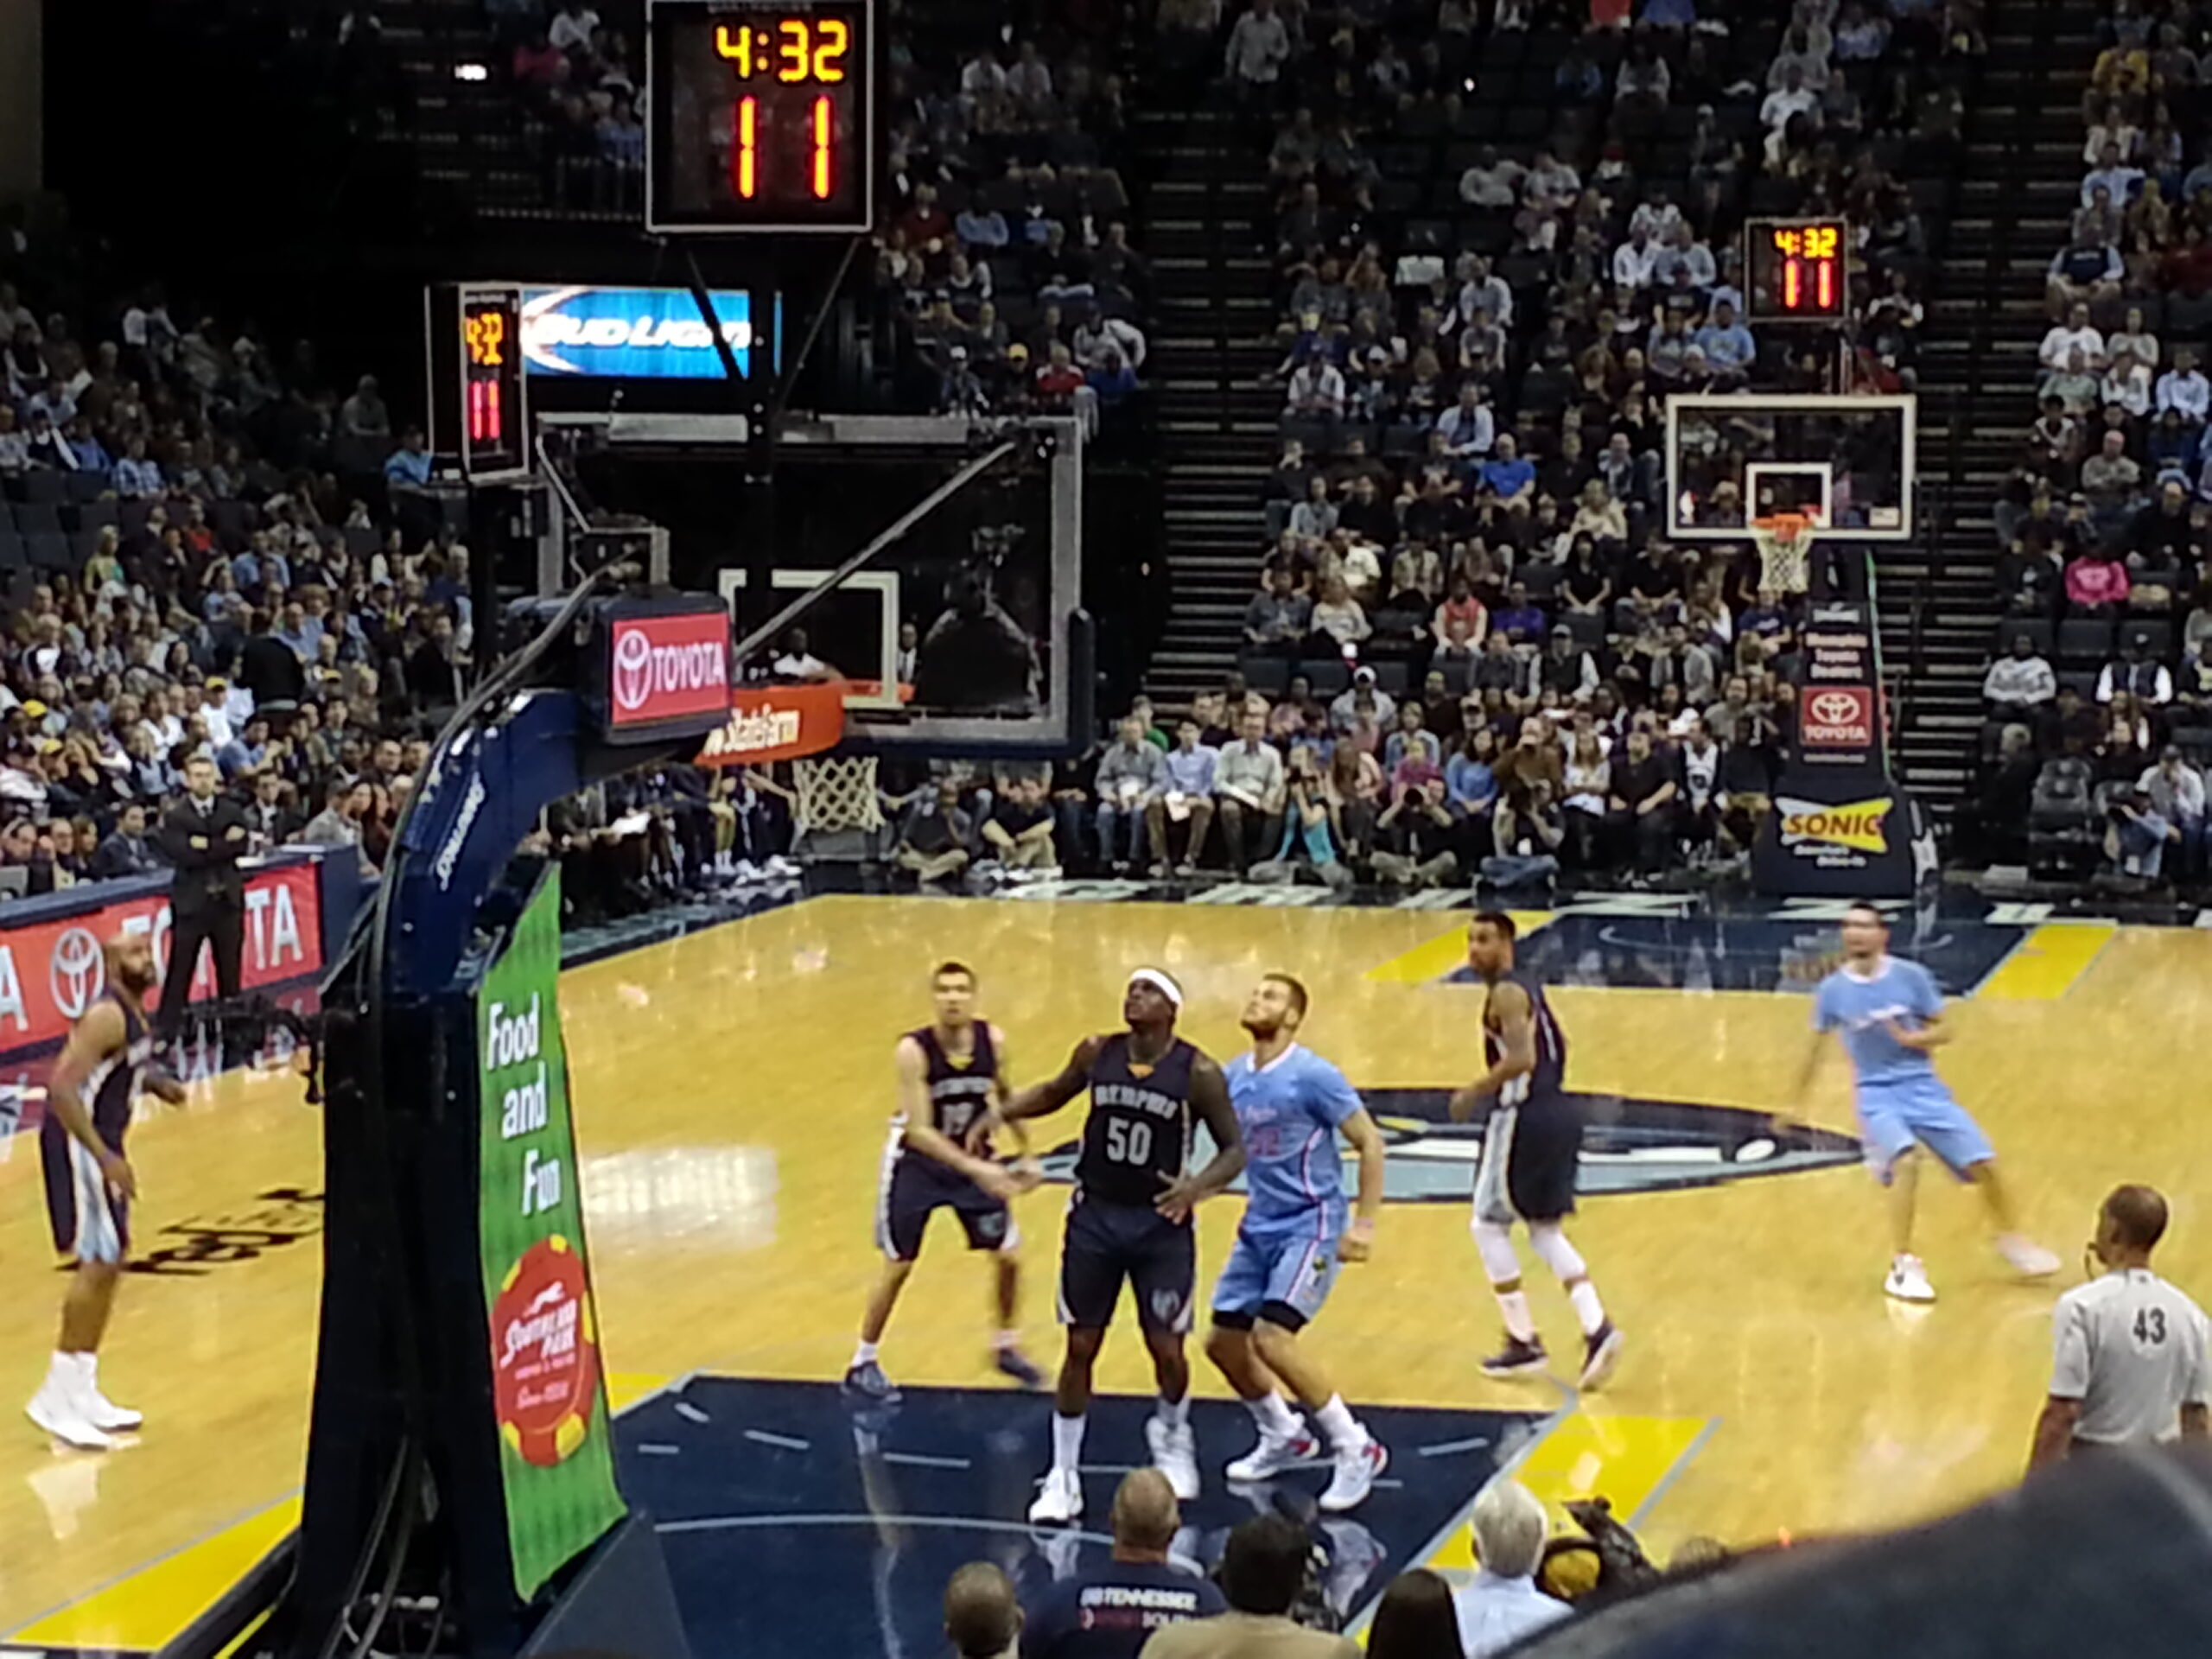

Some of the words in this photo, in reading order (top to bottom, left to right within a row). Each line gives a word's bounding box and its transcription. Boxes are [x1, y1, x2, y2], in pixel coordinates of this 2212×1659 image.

[715, 20, 848, 81] 4:32
[739, 95, 830, 199] 11
[1774, 229, 1838, 258] 4:32
[1784, 259, 1832, 308] 11
[652, 642, 726, 692] TOYOTA
[1804, 725, 1867, 741] TOYOTA
[1786, 812, 1880, 836] SONIC
[486, 991, 540, 1071] Food
[502, 1060, 547, 1140] and
[1107, 1116, 1152, 1166] 50
[522, 1148, 561, 1216] Fun
[2133, 1306, 2166, 1344] 43
